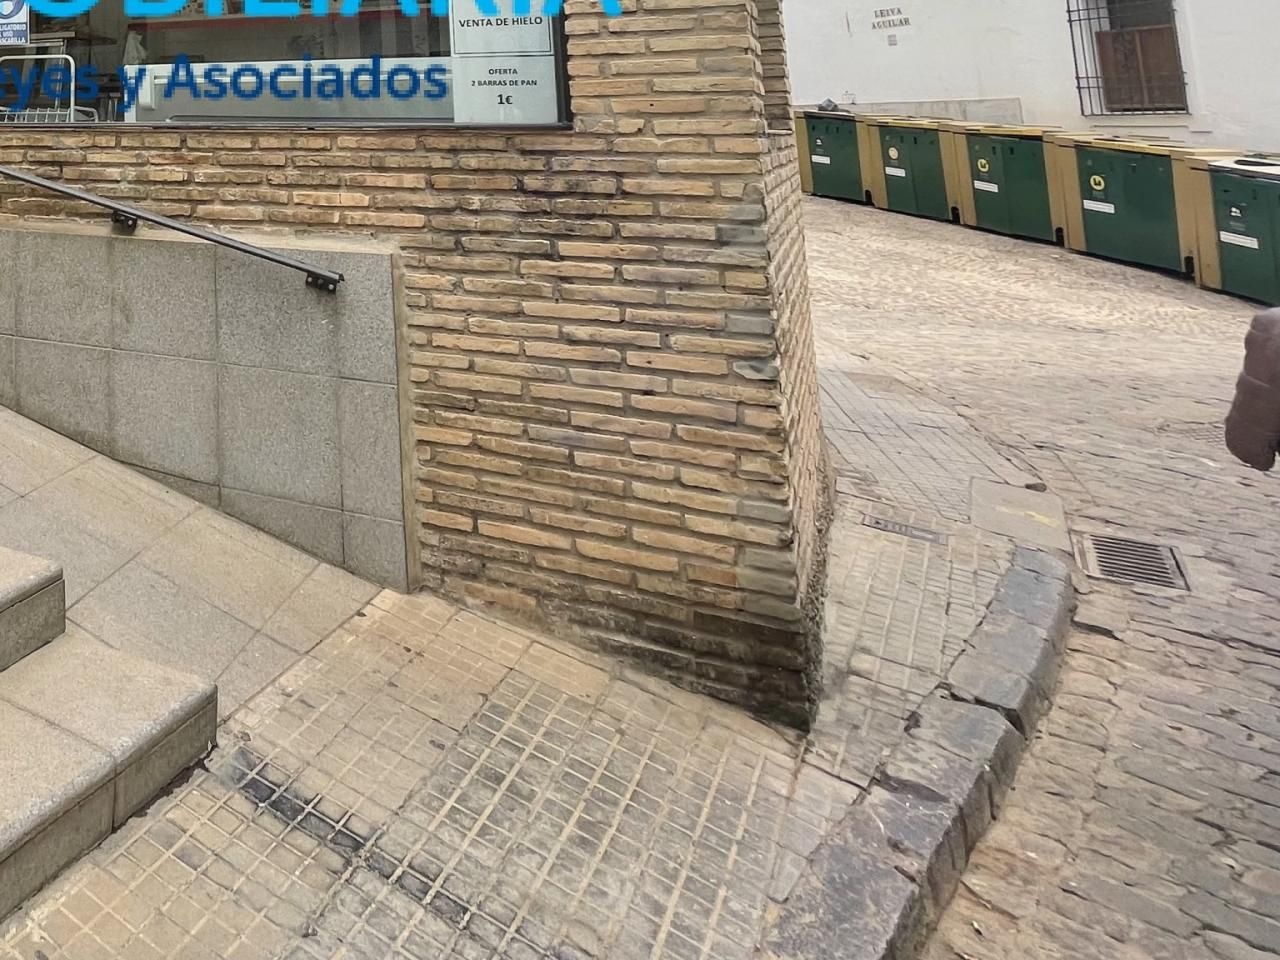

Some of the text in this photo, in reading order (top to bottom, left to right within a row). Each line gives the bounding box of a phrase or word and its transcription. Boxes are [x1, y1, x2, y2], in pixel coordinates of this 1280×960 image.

[874, 7, 903, 18] LEIVA
[459, 16, 543, 28] VENTA DE HIELO
[872, 17, 911, 30] AGUILAR
[497, 94, 513, 105] 1€
